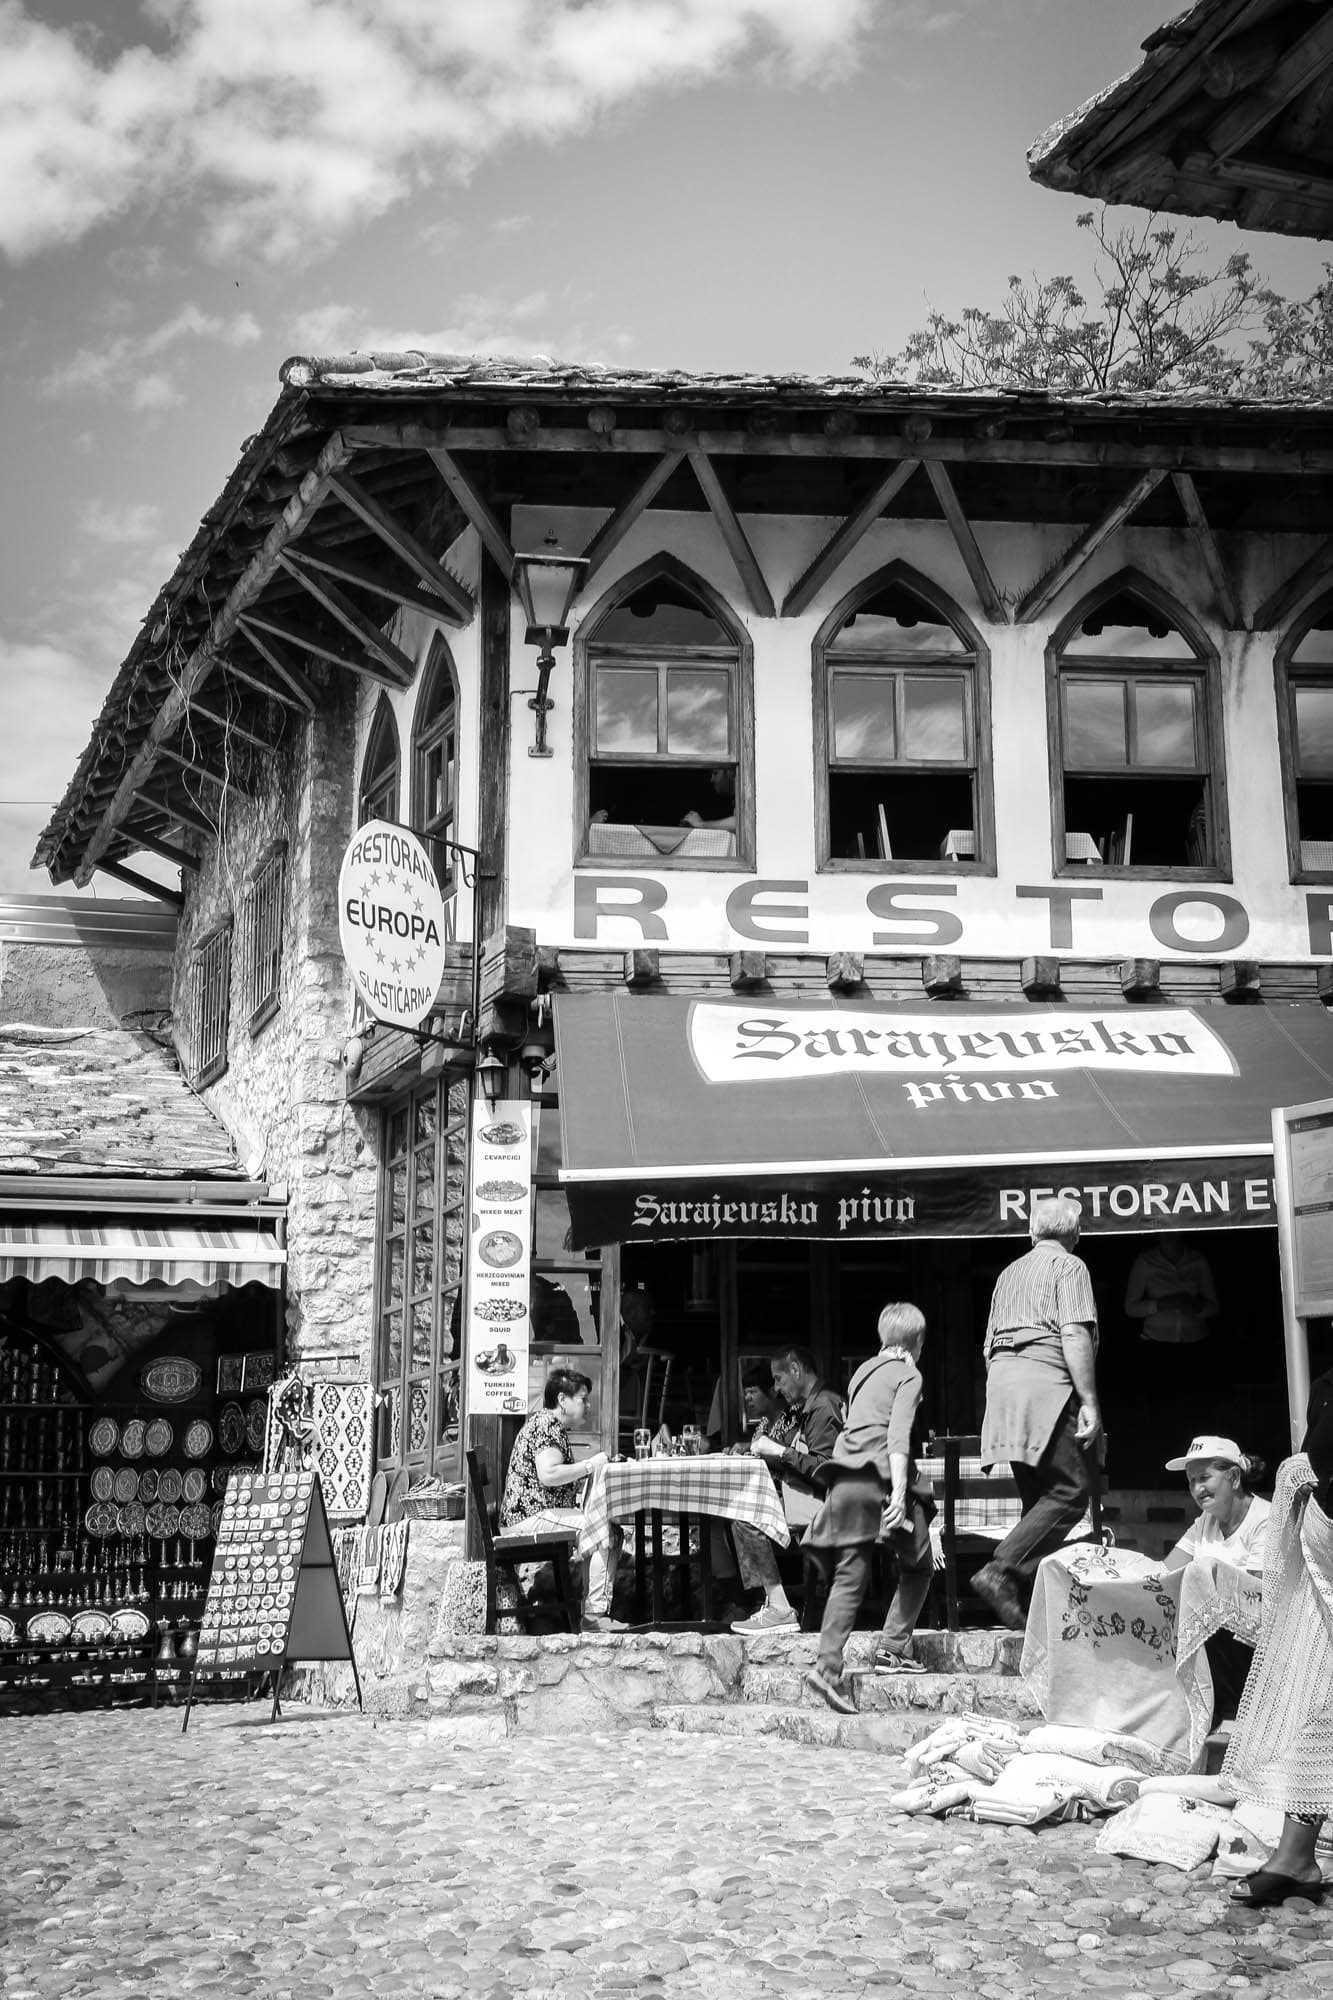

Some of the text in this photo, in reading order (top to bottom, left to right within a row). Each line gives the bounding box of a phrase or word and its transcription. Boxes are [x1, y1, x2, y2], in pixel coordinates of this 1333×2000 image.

[351, 832, 435, 889] RESTORAN
[346, 898, 441, 947] EUROPA
[572, 874, 1333, 956] RESTO
[359, 970, 432, 1014] SLASTIČARNA
[733, 1018, 1196, 1068] Sarajevsko
[901, 1074, 1060, 1109] pivo
[630, 1186, 916, 1231] Sarajevsko pivo
[1244, 1177, 1278, 1211] E
